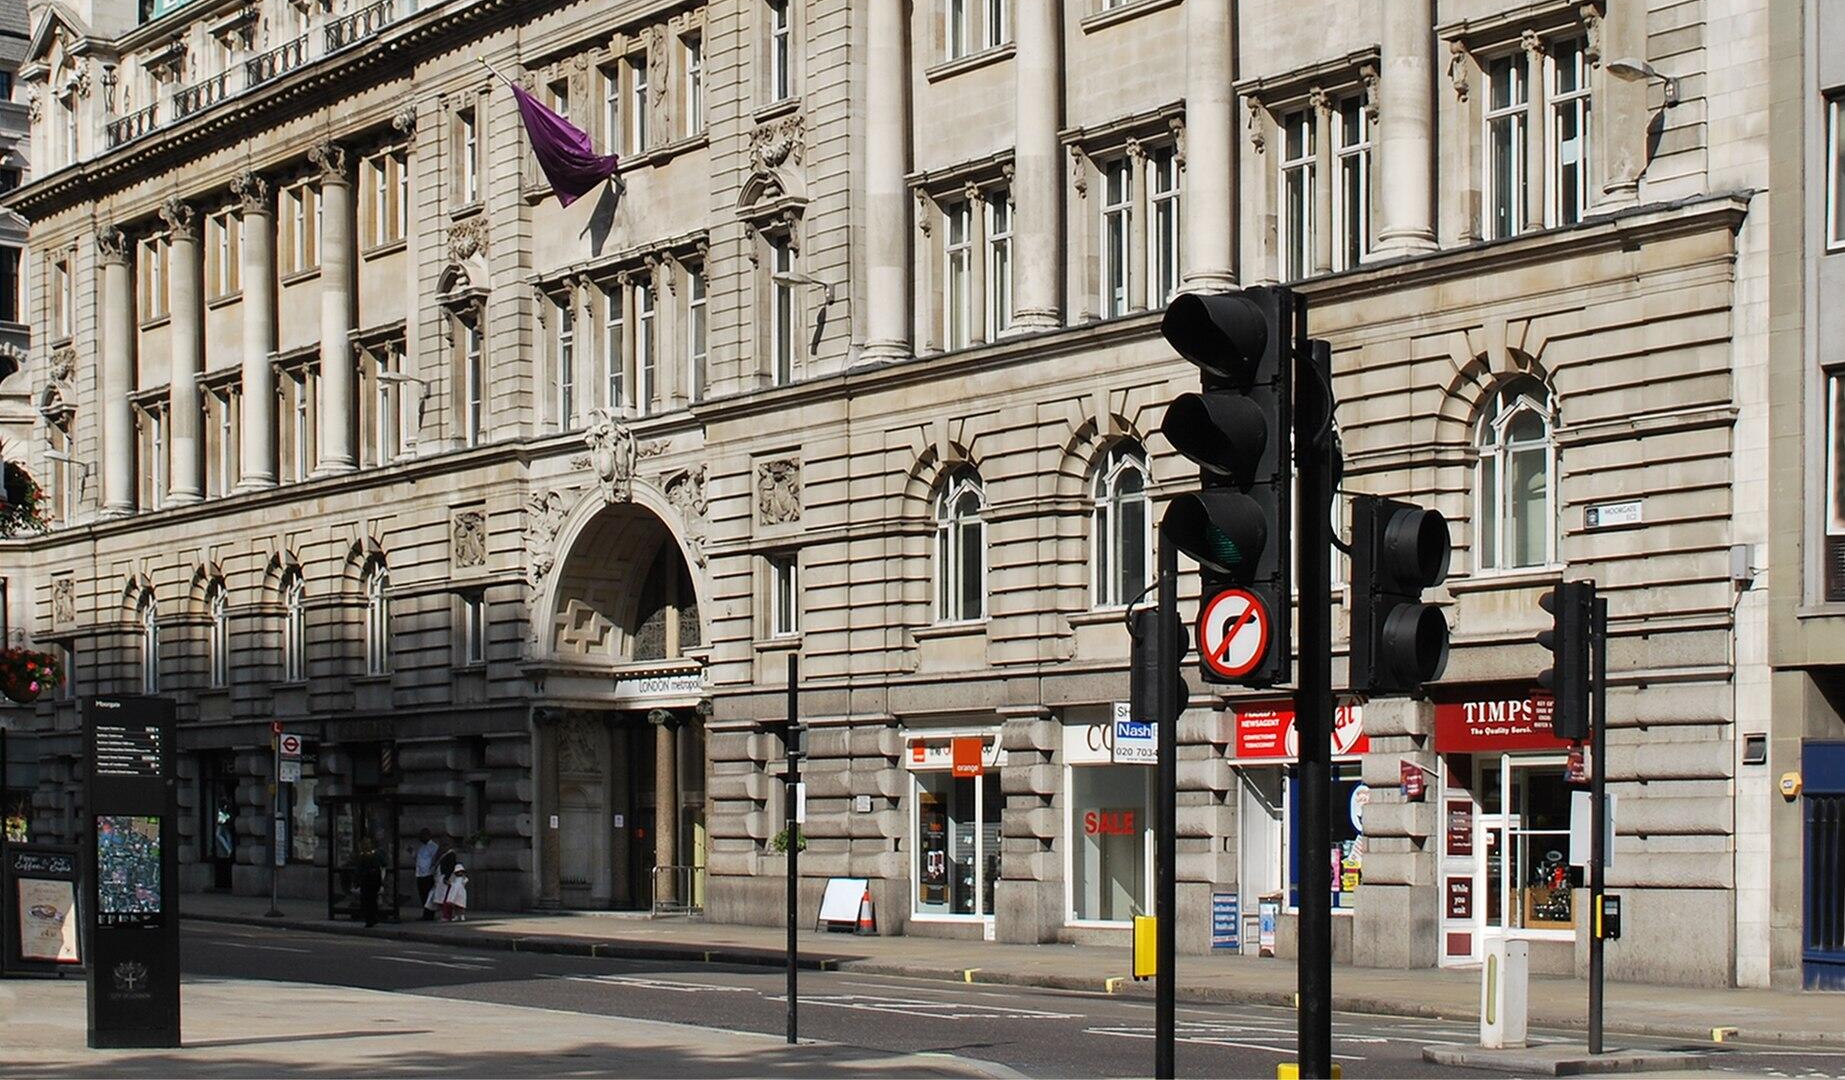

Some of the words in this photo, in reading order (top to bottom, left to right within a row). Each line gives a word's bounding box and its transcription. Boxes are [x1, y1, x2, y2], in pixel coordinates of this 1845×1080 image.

[1604, 505, 1637, 515] MOORGATE
[639, 680, 669, 693] LONDON
[274, 721, 281, 733] L
[1241, 719, 1279, 728] NEWSAGENT
[1118, 723, 1151, 737] Nash
[1485, 726, 1509, 735] Quality
[1116, 747, 1133, 756] 020
[957, 765, 979, 773] orange
[1084, 812, 1136, 836] SALE
[1451, 884, 1469, 893] While
[1454, 896, 1466, 906] you
[1453, 906, 1466, 914] wait
